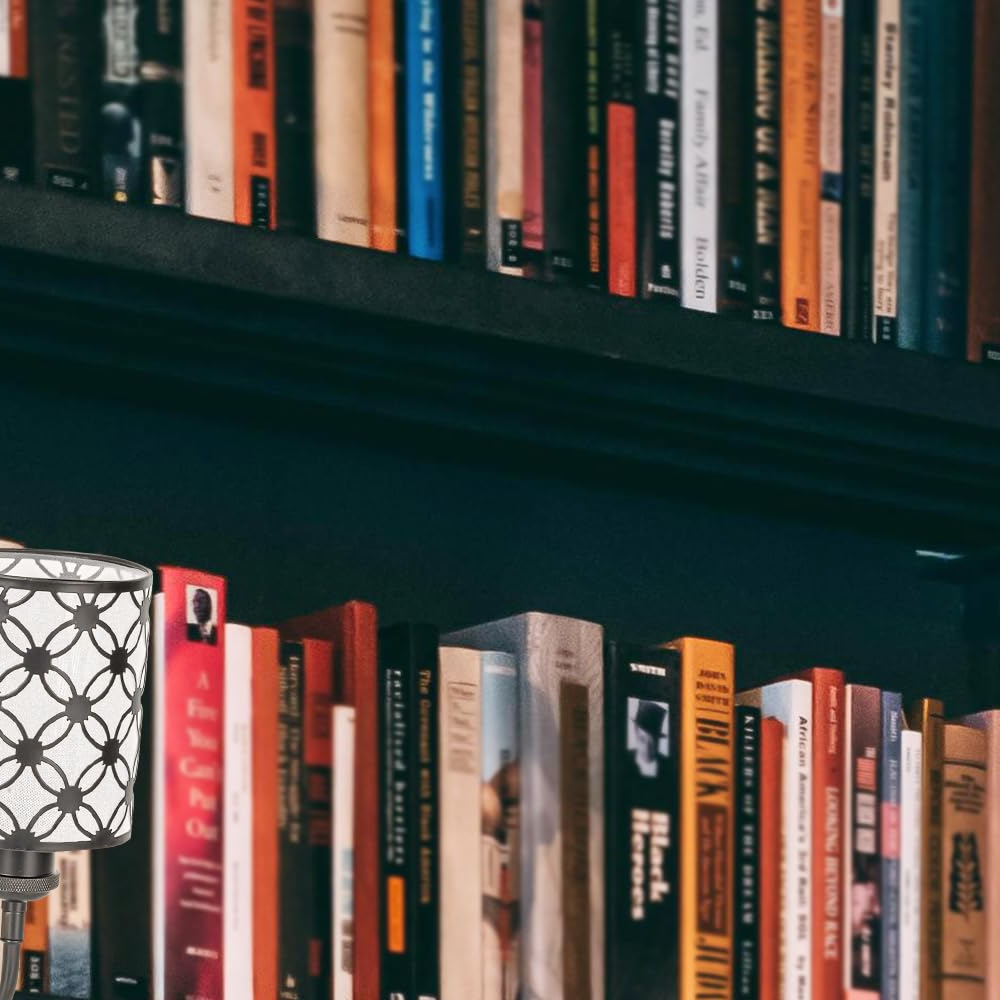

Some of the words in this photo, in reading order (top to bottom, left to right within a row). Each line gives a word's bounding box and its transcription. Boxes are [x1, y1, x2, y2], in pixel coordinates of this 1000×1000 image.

[883, 22, 897, 91] Stanley
[657, 119, 674, 176] Dorothy
[693, 89, 709, 149] Family
[882, 97, 896, 182] Robinson
[659, 182, 674, 239] Roberts
[695, 157, 709, 208] Affair
[695, 236, 709, 300] Bolden
[418, 669, 432, 694] The
[742, 715, 754, 787] KILLERS
[797, 715, 808, 767] African
[889, 709, 899, 743] Smith
[695, 717, 730, 799] BLACK
[743, 794, 753, 816] OF
[796, 772, 808, 844] America's
[824, 786, 839, 853] LOOKING
[630, 808, 649, 921] Heroes
[649, 811, 670, 903] Black
[742, 824, 754, 856] THE
[797, 849, 808, 871] 3rd
[419, 847, 432, 904] America
[741, 865, 753, 924] DREAM
[825, 856, 839, 916] BEYOND
[795, 956, 808, 971] by
[824, 920, 839, 960] RACE
